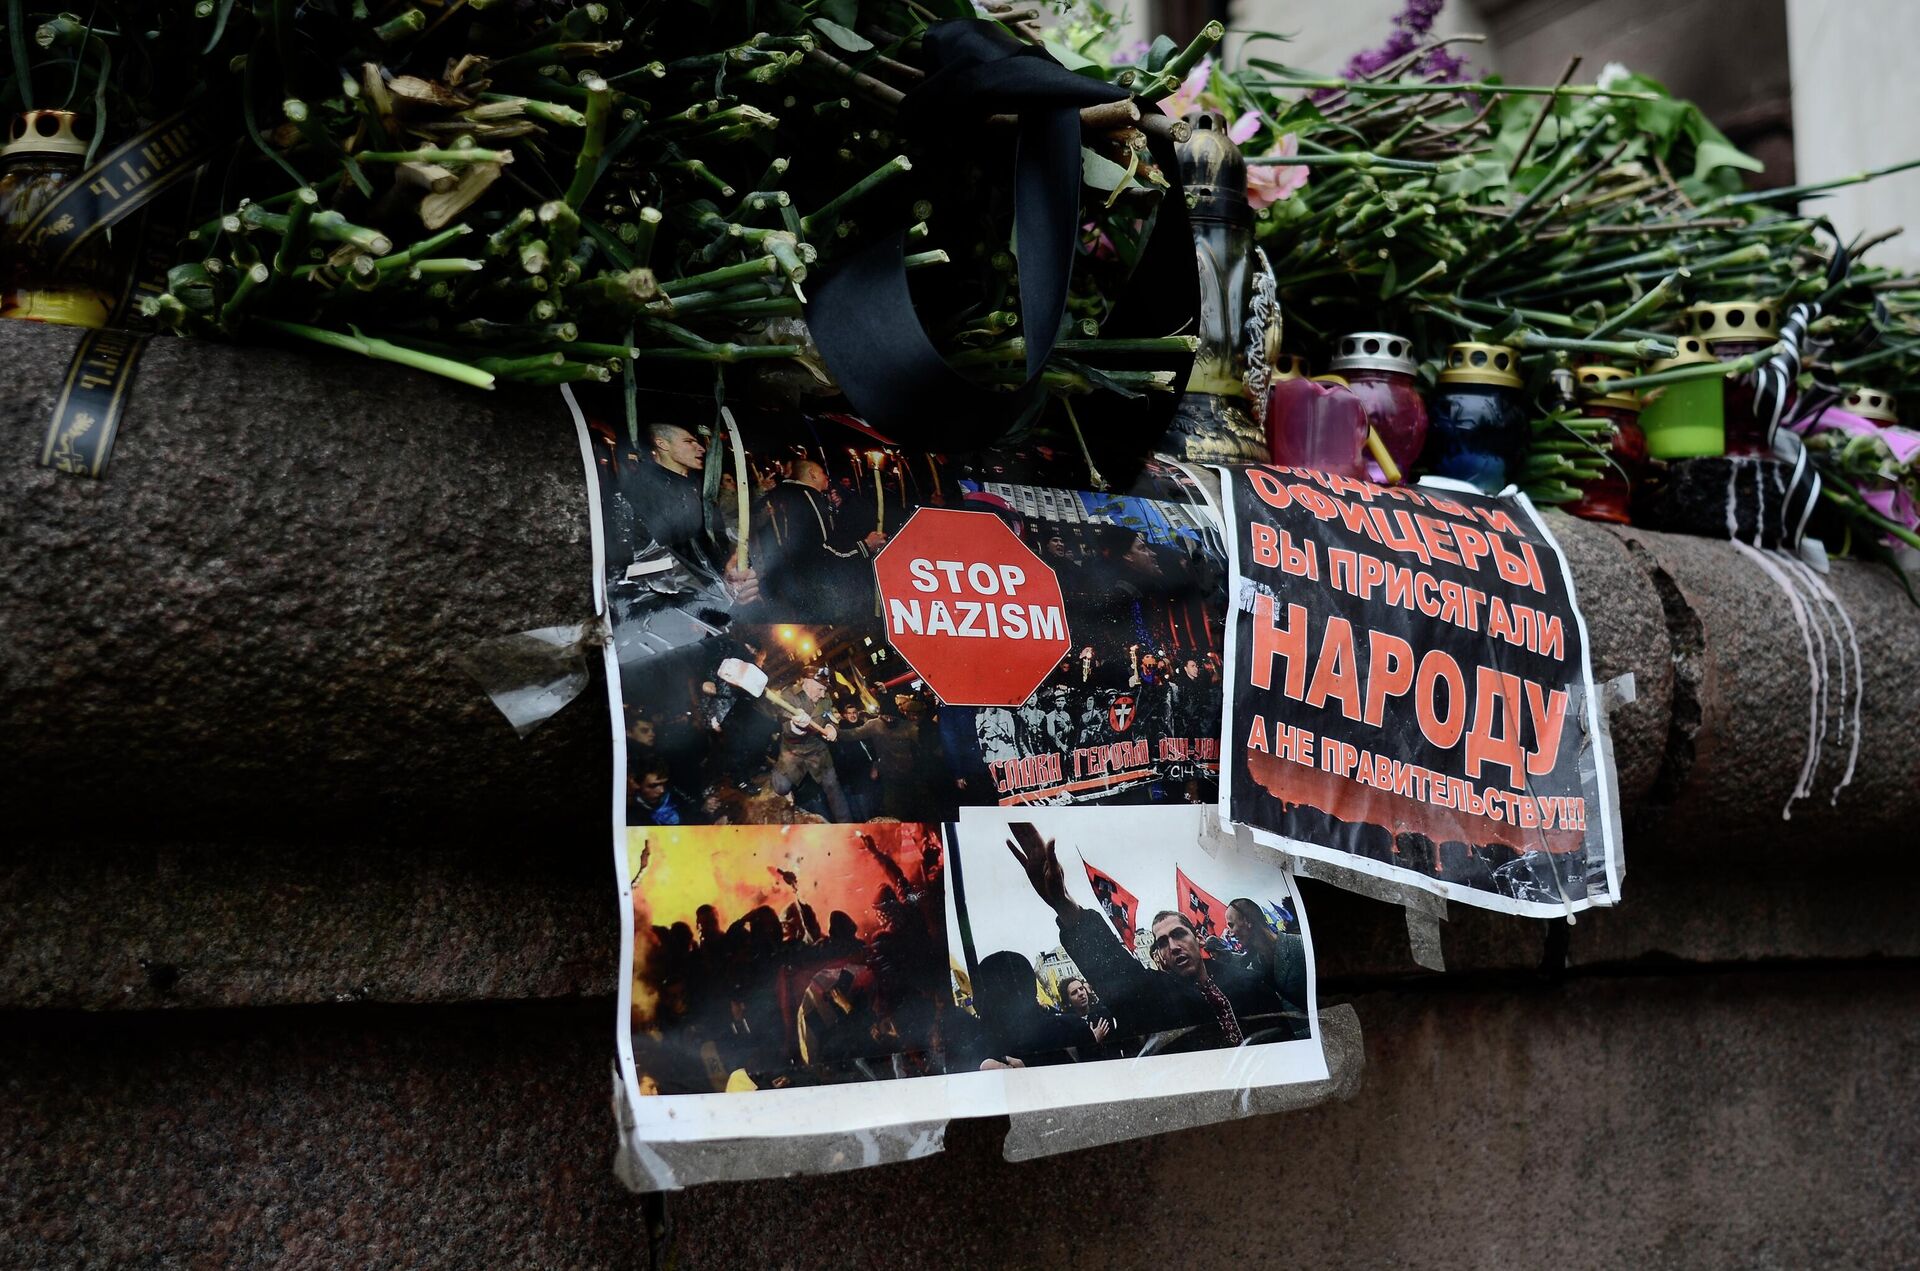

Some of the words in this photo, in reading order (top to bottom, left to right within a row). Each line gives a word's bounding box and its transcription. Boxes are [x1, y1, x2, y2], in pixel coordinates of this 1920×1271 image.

[909, 558, 1026, 596] STOP
[1245, 468, 1547, 595] ОФИЦЕРЫ
[889, 598, 1066, 641] NAZISM
[1250, 522, 1319, 582] ВЫ
[1328, 546, 1565, 662] ПРИСЯГАЛИ
[1250, 595, 1569, 790] НАРОДУ
[988, 752, 1063, 793] СЛАВА
[1073, 739, 1150, 778] ГЕРОЯМ
[1247, 714, 1270, 754] А
[1275, 721, 1315, 767] НЕ
[1321, 737, 1586, 832] ПРАВИТЕЛЬСТВУ!!!
